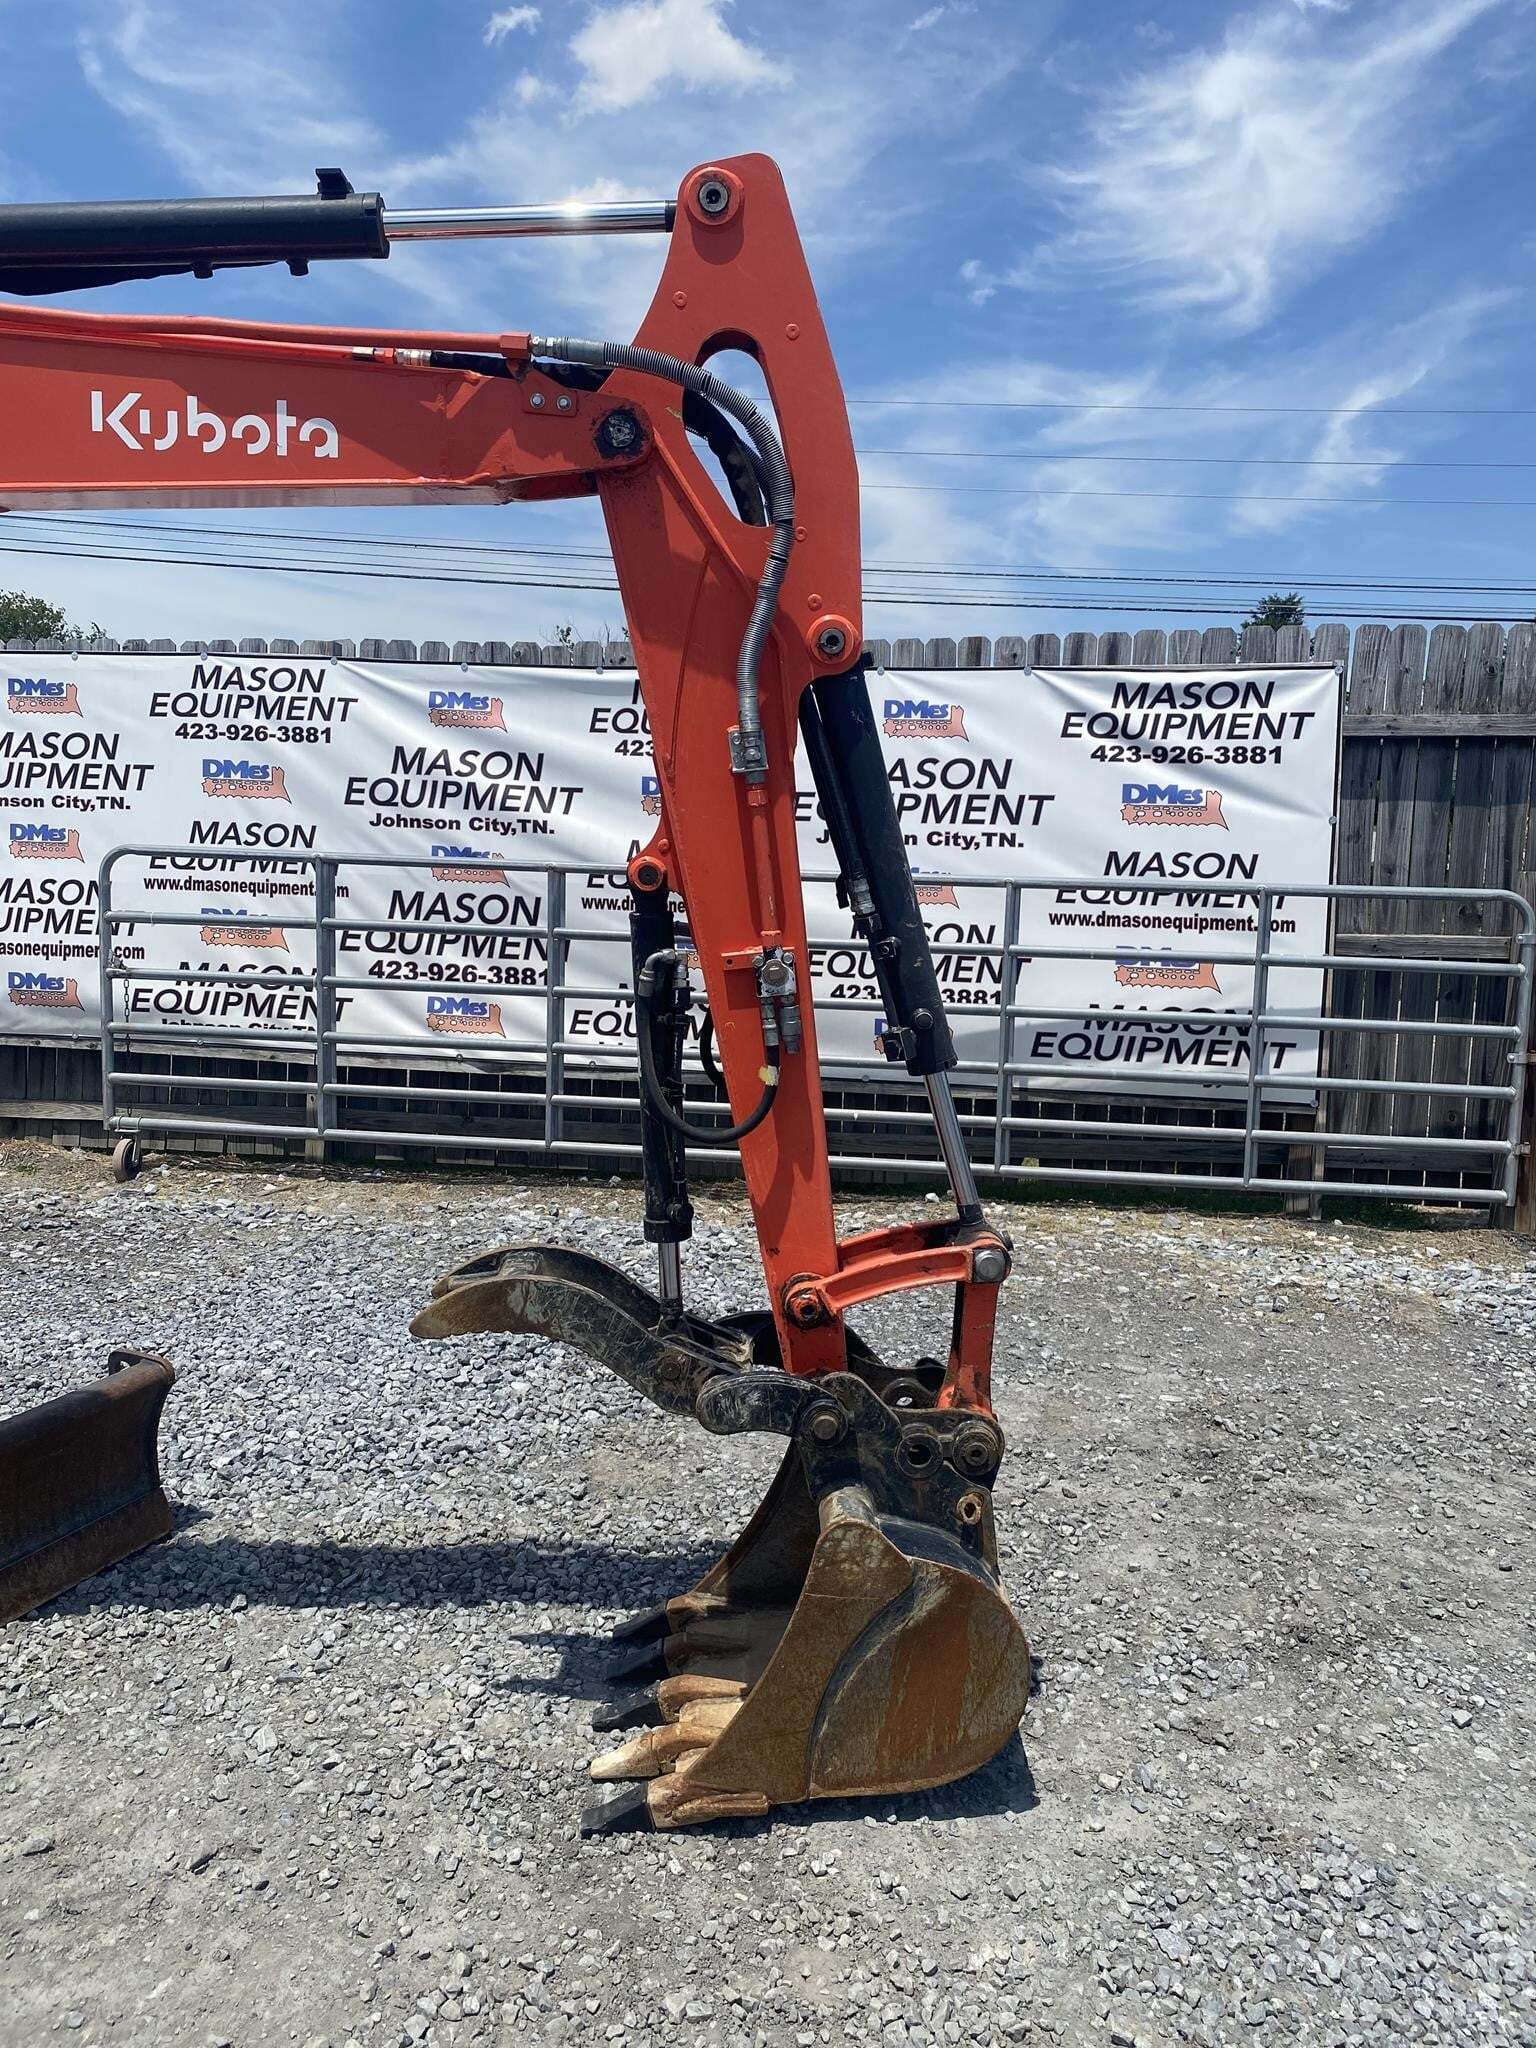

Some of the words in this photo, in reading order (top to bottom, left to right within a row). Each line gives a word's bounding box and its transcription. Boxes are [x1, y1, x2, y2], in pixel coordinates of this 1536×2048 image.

[90, 391, 339, 458] Kubota
[191, 665, 326, 693] MASON
[149, 692, 358, 722] EQUIPMENT
[1110, 681, 1275, 710] MASON
[175, 723, 332, 743] 423-926-3881
[1060, 711, 1315, 741] EQUIPMENT
[391, 745, 544, 782] MASON
[1090, 745, 1282, 765] 423-926-3881
[0, 761, 154, 791] UIPMENT
[887, 758, 1012, 790] ASON
[0, 795, 45, 808] nson
[51, 794, 131, 812] City,TN.
[344, 776, 583, 815] EQUIPMENT
[795, 791, 1055, 826] EPMENT
[189, 820, 316, 848] MASON
[369, 813, 461, 830] Johnson
[469, 818, 555, 836] City,TN.
[926, 831, 1024, 850] City,TN.
[150, 855, 338, 876] EQUIPME
[1103, 850, 1259, 879] MASON
[144, 875, 350, 898] www.dmasonequipment.m
[388, 889, 542, 926] MASON
[1049, 910, 1296, 934] www.dmasonequipment.om
[0, 940, 145, 961] asonequipmencom
[339, 930, 571, 963] EQUIPMEN
[132, 988, 353, 1022] EQUIPMENT
[830, 983, 1002, 1005] 423-3881
[1030, 1030, 1297, 1070] EQUIPMENT
